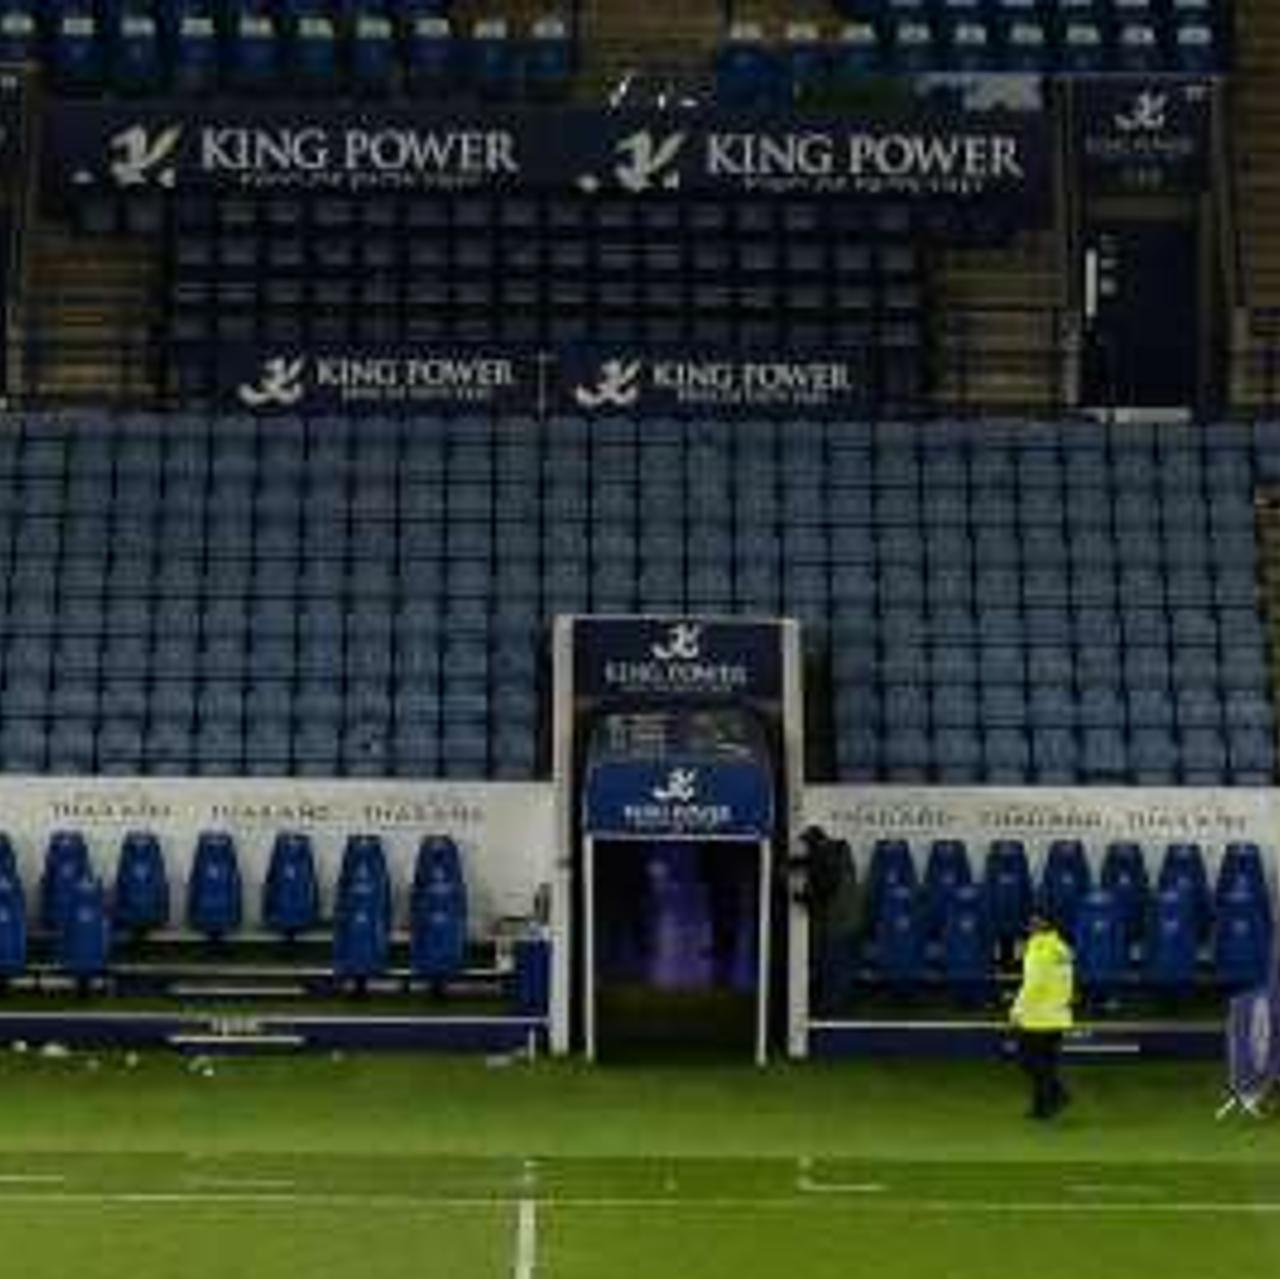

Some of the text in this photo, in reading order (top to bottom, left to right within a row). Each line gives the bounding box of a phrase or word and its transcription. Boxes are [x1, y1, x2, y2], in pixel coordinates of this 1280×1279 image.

[200, 126, 520, 174] KING POWER
[705, 132, 1024, 178] KING POWER
[317, 358, 398, 385] KING
[652, 361, 732, 388] KING
